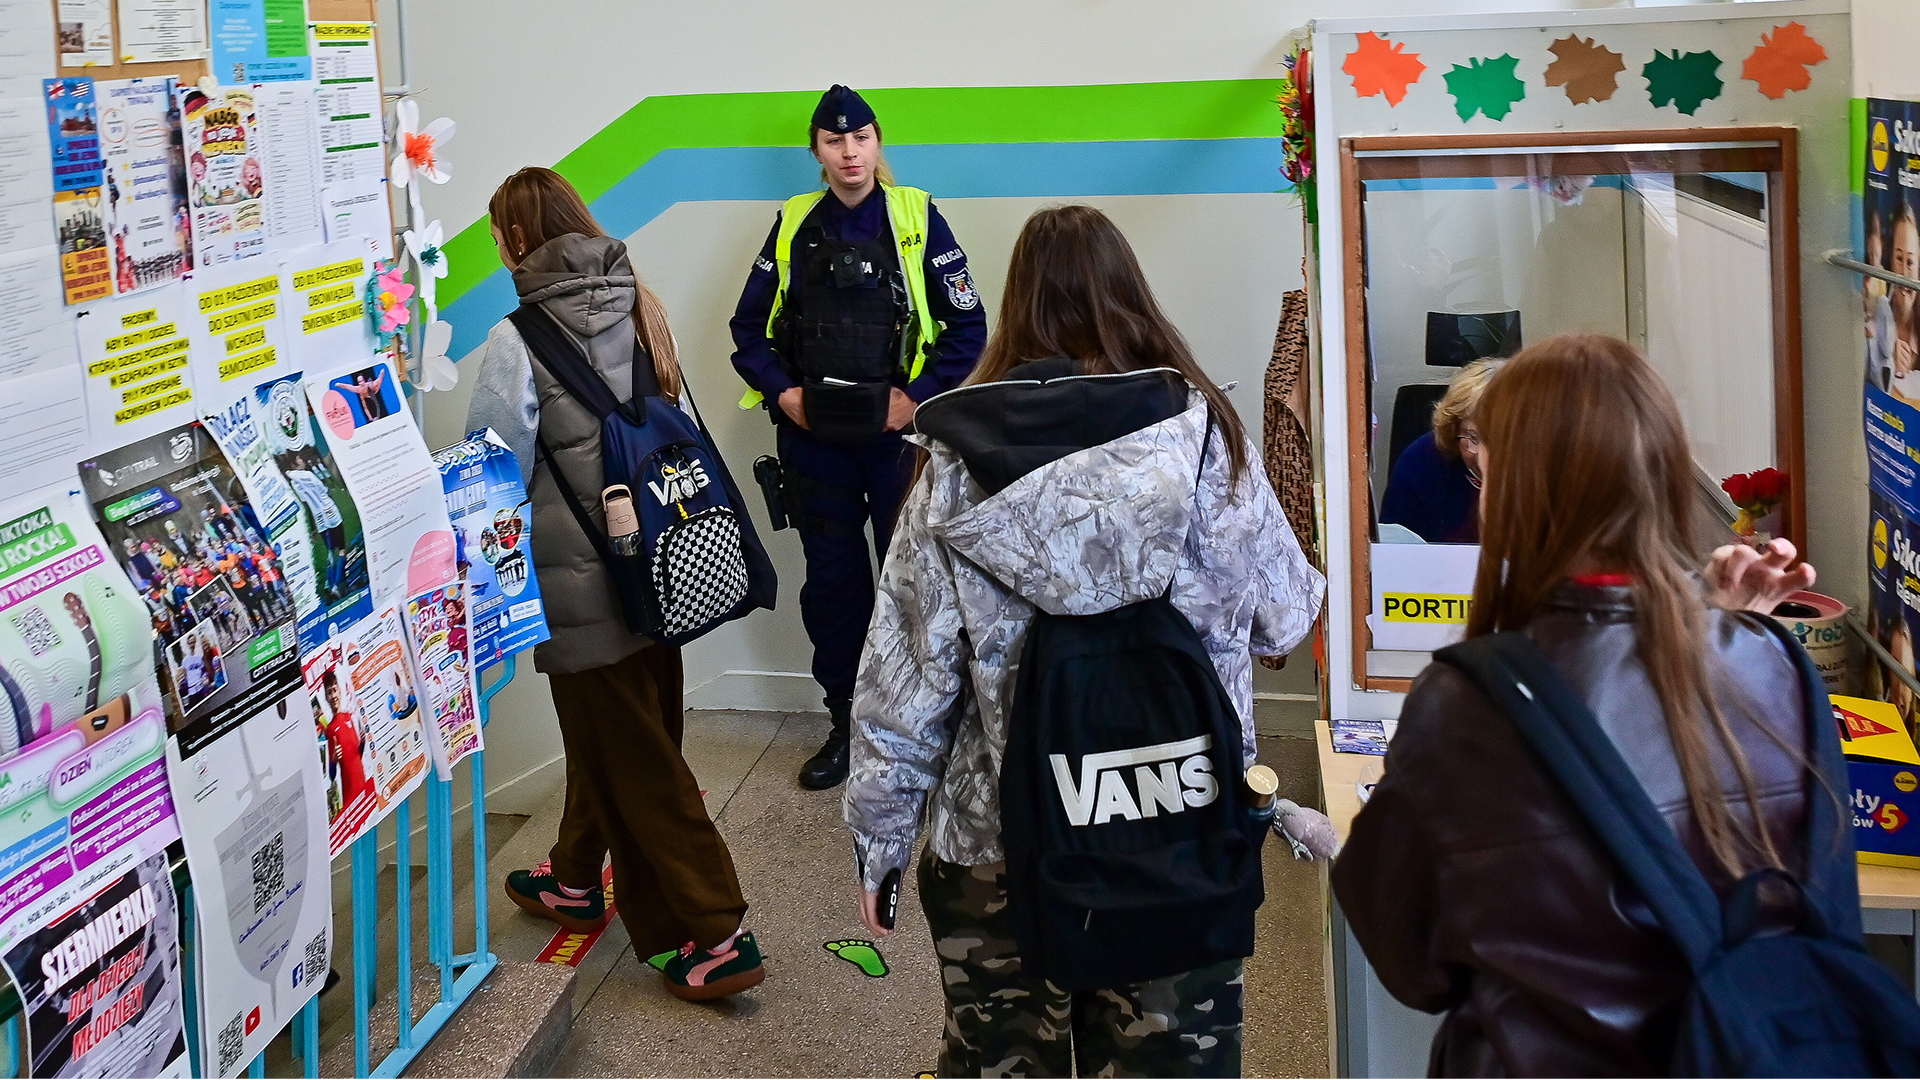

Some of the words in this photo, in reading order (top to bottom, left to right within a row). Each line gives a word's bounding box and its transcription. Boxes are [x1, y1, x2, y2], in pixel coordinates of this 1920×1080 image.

[293, 277, 305, 289] OD
[318, 261, 364, 284] PAŹDZIERNIKA
[200, 298, 212, 311] OD
[228, 279, 279, 304] PAŹDZIERNIKA
[209, 319, 221, 332] DO
[303, 313, 335, 331] ZMIENNE
[337, 304, 364, 322] OBUWIE
[219, 349, 276, 378] SAMODZIELNIE
[3, 526, 67, 567] ROCKA!
[7, 568, 57, 601] TWOJEJ
[53, 547, 101, 580] SZKOLE
[60, 753, 92, 787] DZIEŃ
[1048, 734, 1219, 827] VANS
[41, 882, 158, 997] SZERMIERKA
[68, 977, 95, 1026] DLA
[73, 980, 145, 1063] MŁODZIEŻY
